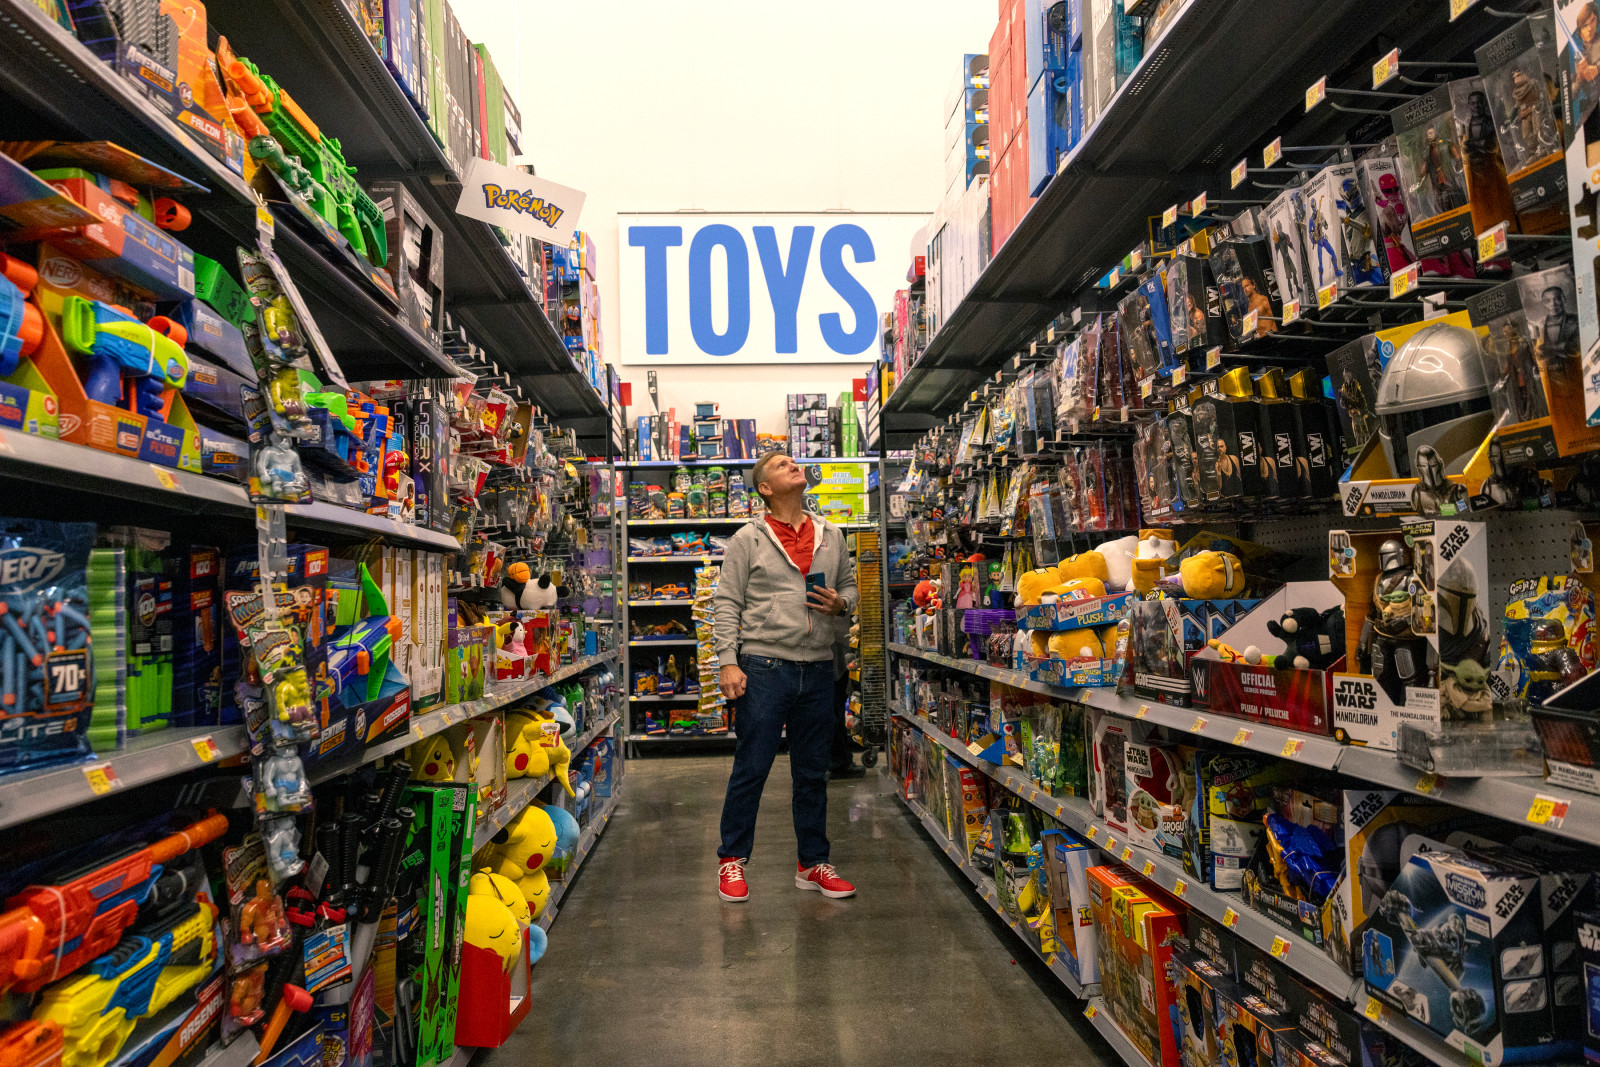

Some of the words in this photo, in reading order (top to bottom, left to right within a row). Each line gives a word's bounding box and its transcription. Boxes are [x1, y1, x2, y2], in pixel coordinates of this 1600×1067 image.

[1404, 102, 1436, 122] WARS
[1405, 96, 1434, 114] STAR
[190, 114, 221, 140] FALCON
[628, 224, 878, 356] TOYS
[1393, 277, 1406, 294] 1697
[1477, 290, 1505, 306] STAR
[1478, 298, 1507, 315] WARS
[419, 401, 430, 460] LASER
[215, 453, 239, 463] FORCE
[1242, 435, 1255, 464] AW
[1277, 436, 1290, 465] AW
[1309, 436, 1323, 464] AW
[418, 462, 431, 473] X
[1345, 486, 1360, 508] STAR
[1347, 489, 1363, 515] WARS
[1439, 525, 1466, 557] STAR
[1442, 528, 1470, 562] WARS
[196, 561, 210, 576] 100
[308, 560, 321, 574] 100
[139, 597, 156, 618] 100
[1077, 612, 1104, 626] PLUSH
[1084, 668, 1101, 677] PLUSH
[1241, 672, 1276, 689] OFFICIAL
[1335, 680, 1377, 696] STAR
[1335, 693, 1378, 710] WARS
[383, 702, 408, 727] CROSSBOW
[1241, 703, 1259, 715] PLUSH
[1264, 706, 1289, 720] PELUCHE
[1336, 709, 1378, 727] MANDALORIAN
[1390, 710, 1399, 718] THE
[1400, 712, 1435, 721] MANDALORIAN
[323, 733, 344, 753] FORCE
[1126, 746, 1148, 758] STAR
[1127, 754, 1148, 766] WARS
[1349, 793, 1382, 823] STAR
[1352, 797, 1385, 828] WARS
[1163, 821, 1185, 834] GROGU
[402, 850, 424, 869] 155
[1447, 879, 1484, 902] MISSION
[1496, 884, 1522, 914] STAR
[1261, 890, 1275, 907] POWER
[1277, 896, 1298, 915] RANGERS
[1497, 888, 1525, 919] WARS
[180, 992, 224, 1047] ARSENAL
[330, 1012, 347, 1022] 5+
